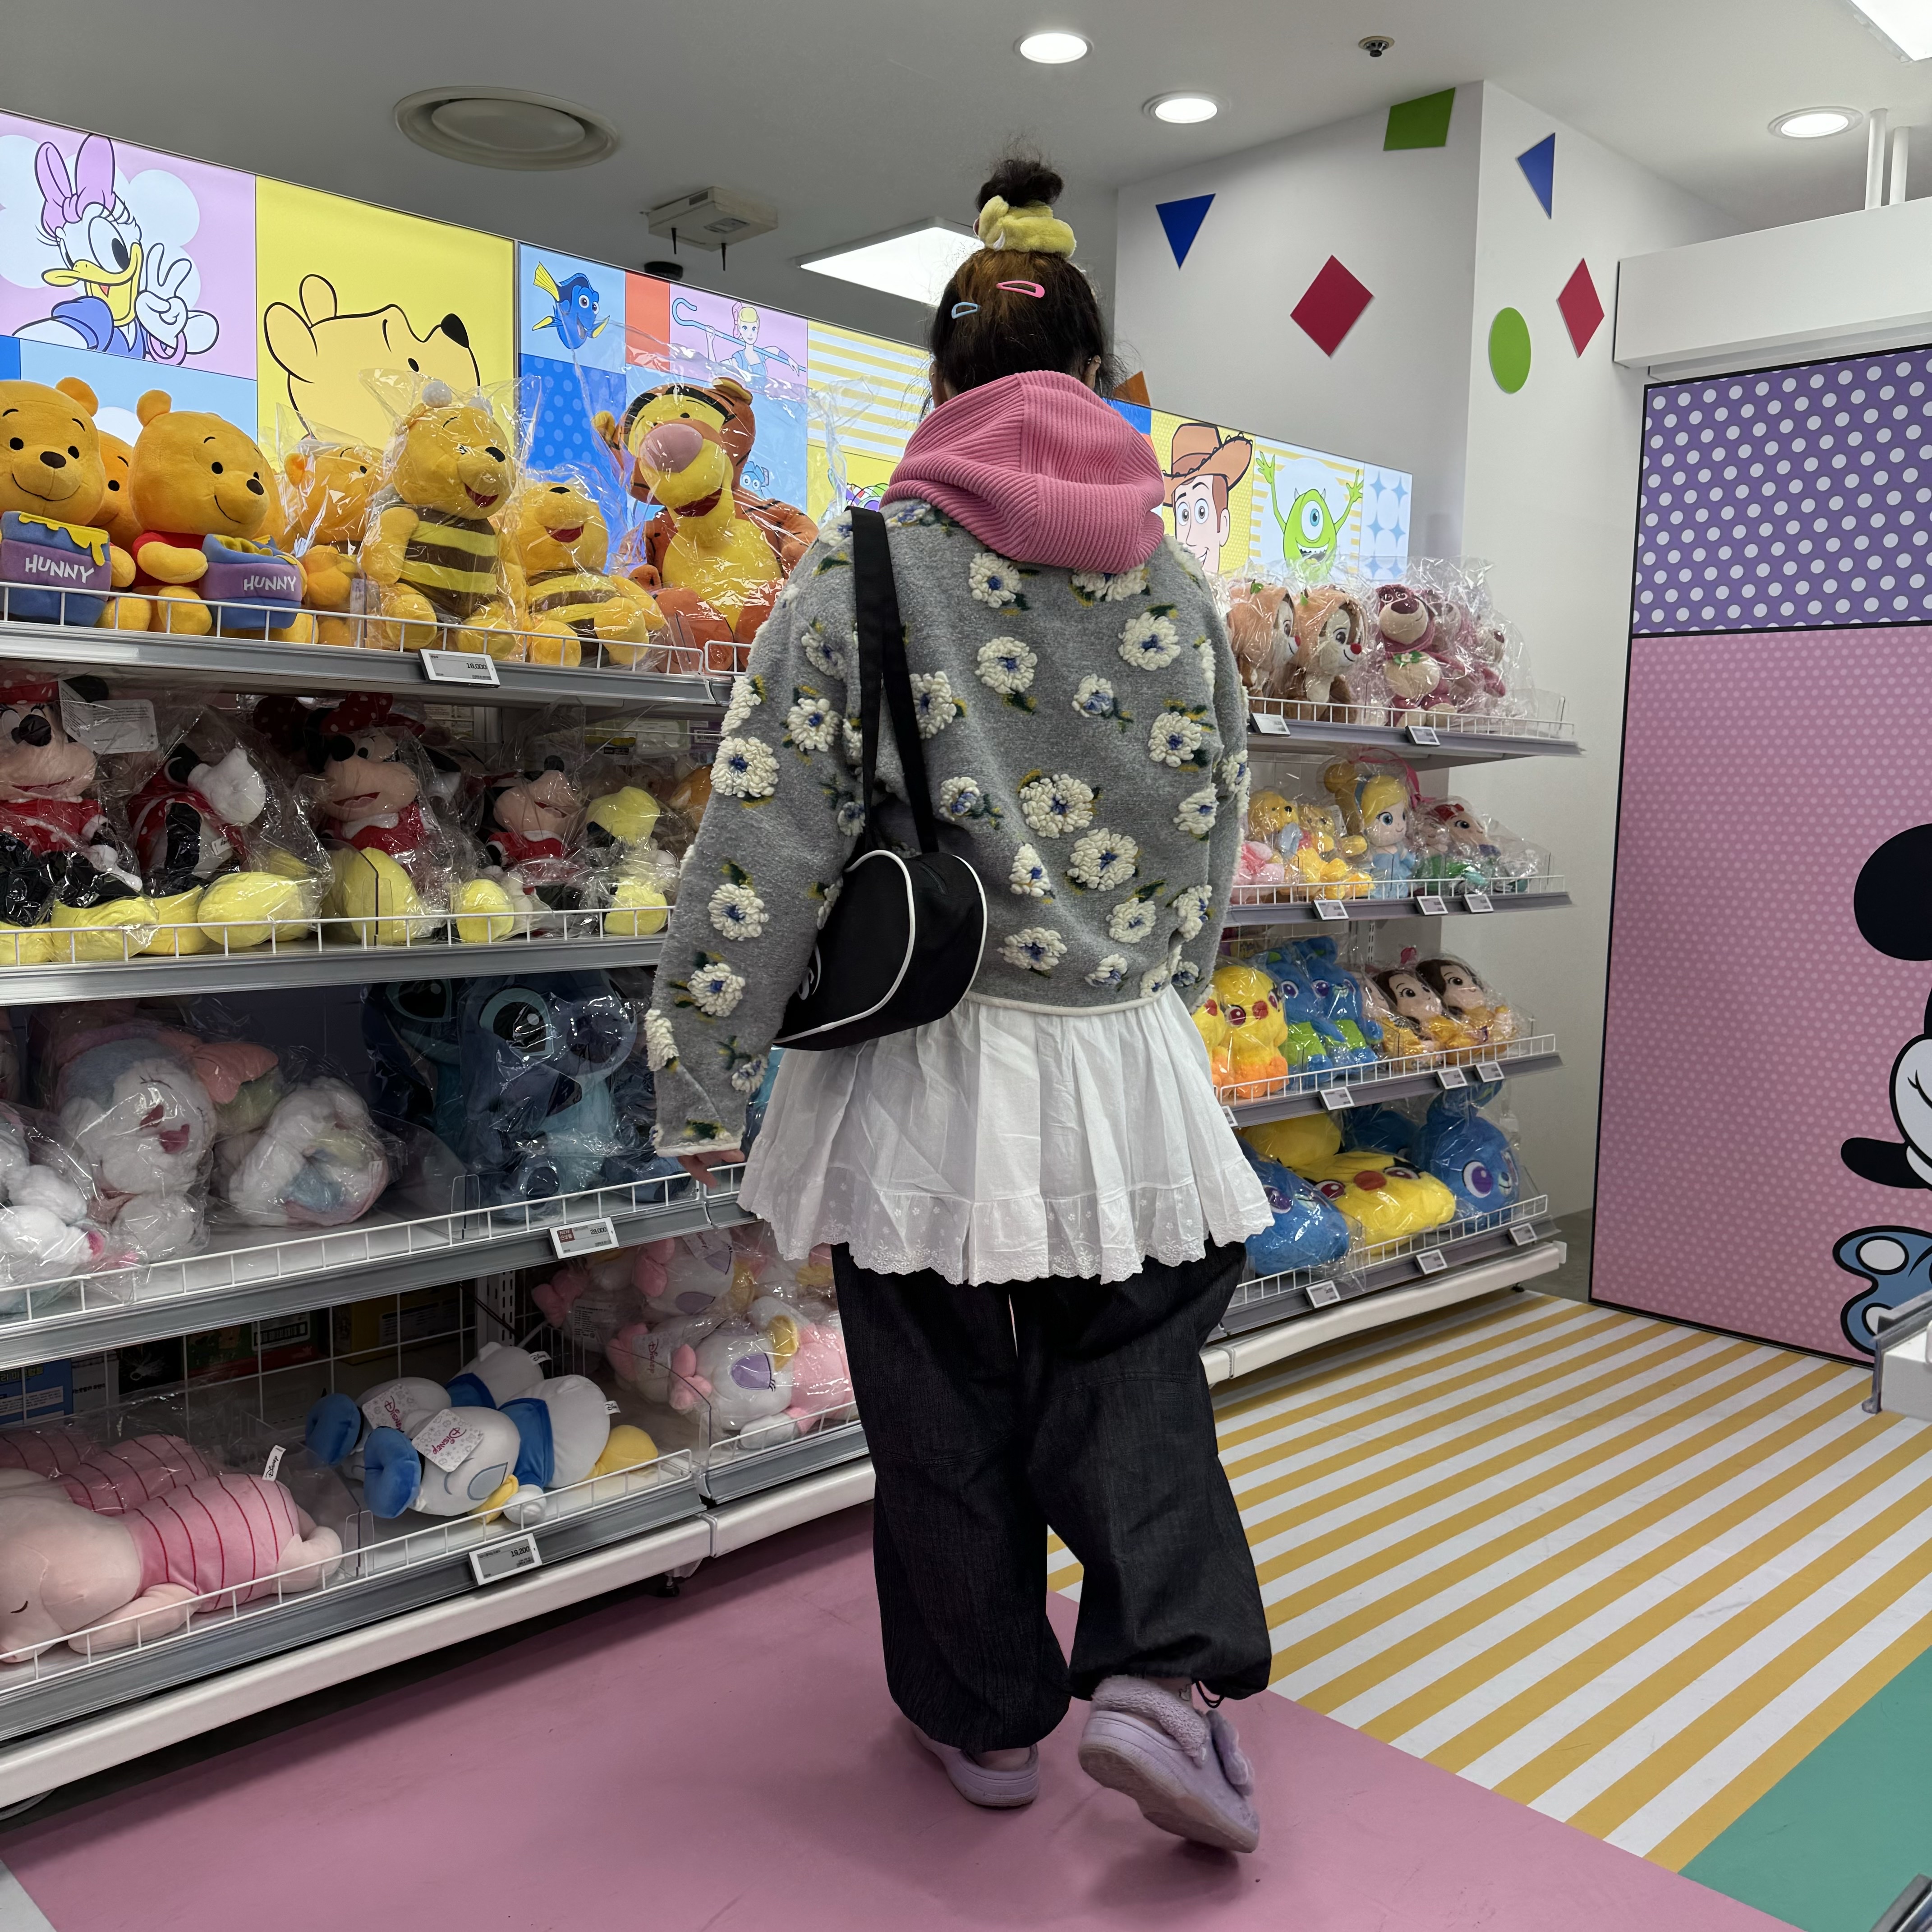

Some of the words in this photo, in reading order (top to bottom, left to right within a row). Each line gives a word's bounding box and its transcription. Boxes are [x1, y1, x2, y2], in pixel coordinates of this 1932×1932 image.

[25, 554, 94, 584] HUNNY
[243, 575, 296, 591] HUNNY
[432, 1427, 467, 1454] Disney
[511, 1546, 530, 1557] 19,200
